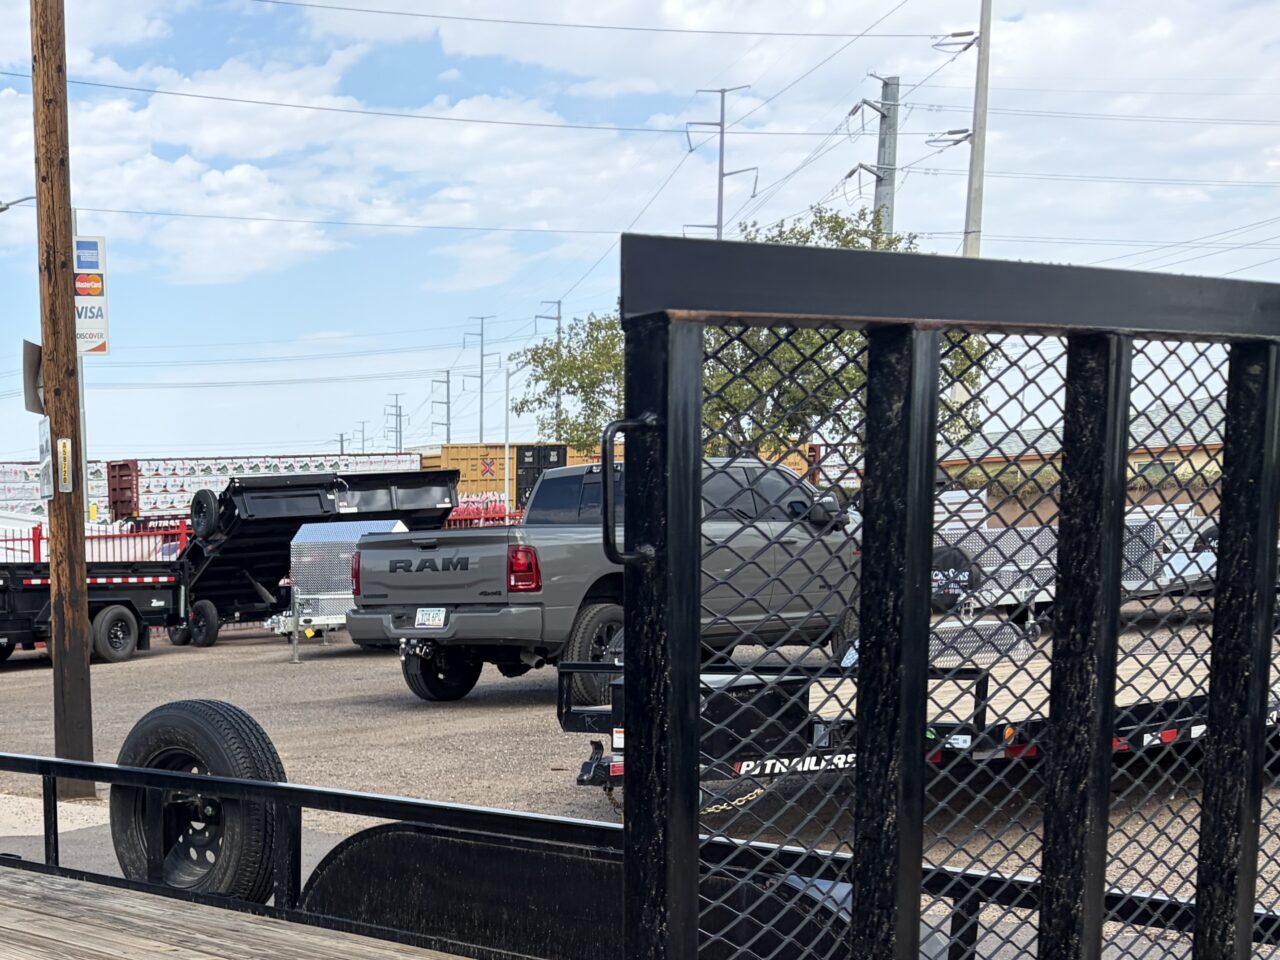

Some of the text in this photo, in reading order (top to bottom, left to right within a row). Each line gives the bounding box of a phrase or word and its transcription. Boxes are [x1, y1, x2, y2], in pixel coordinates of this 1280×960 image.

[76, 306, 104, 320] VISA
[76, 332, 104, 340] DISCOVER
[389, 557, 469, 573] RAM
